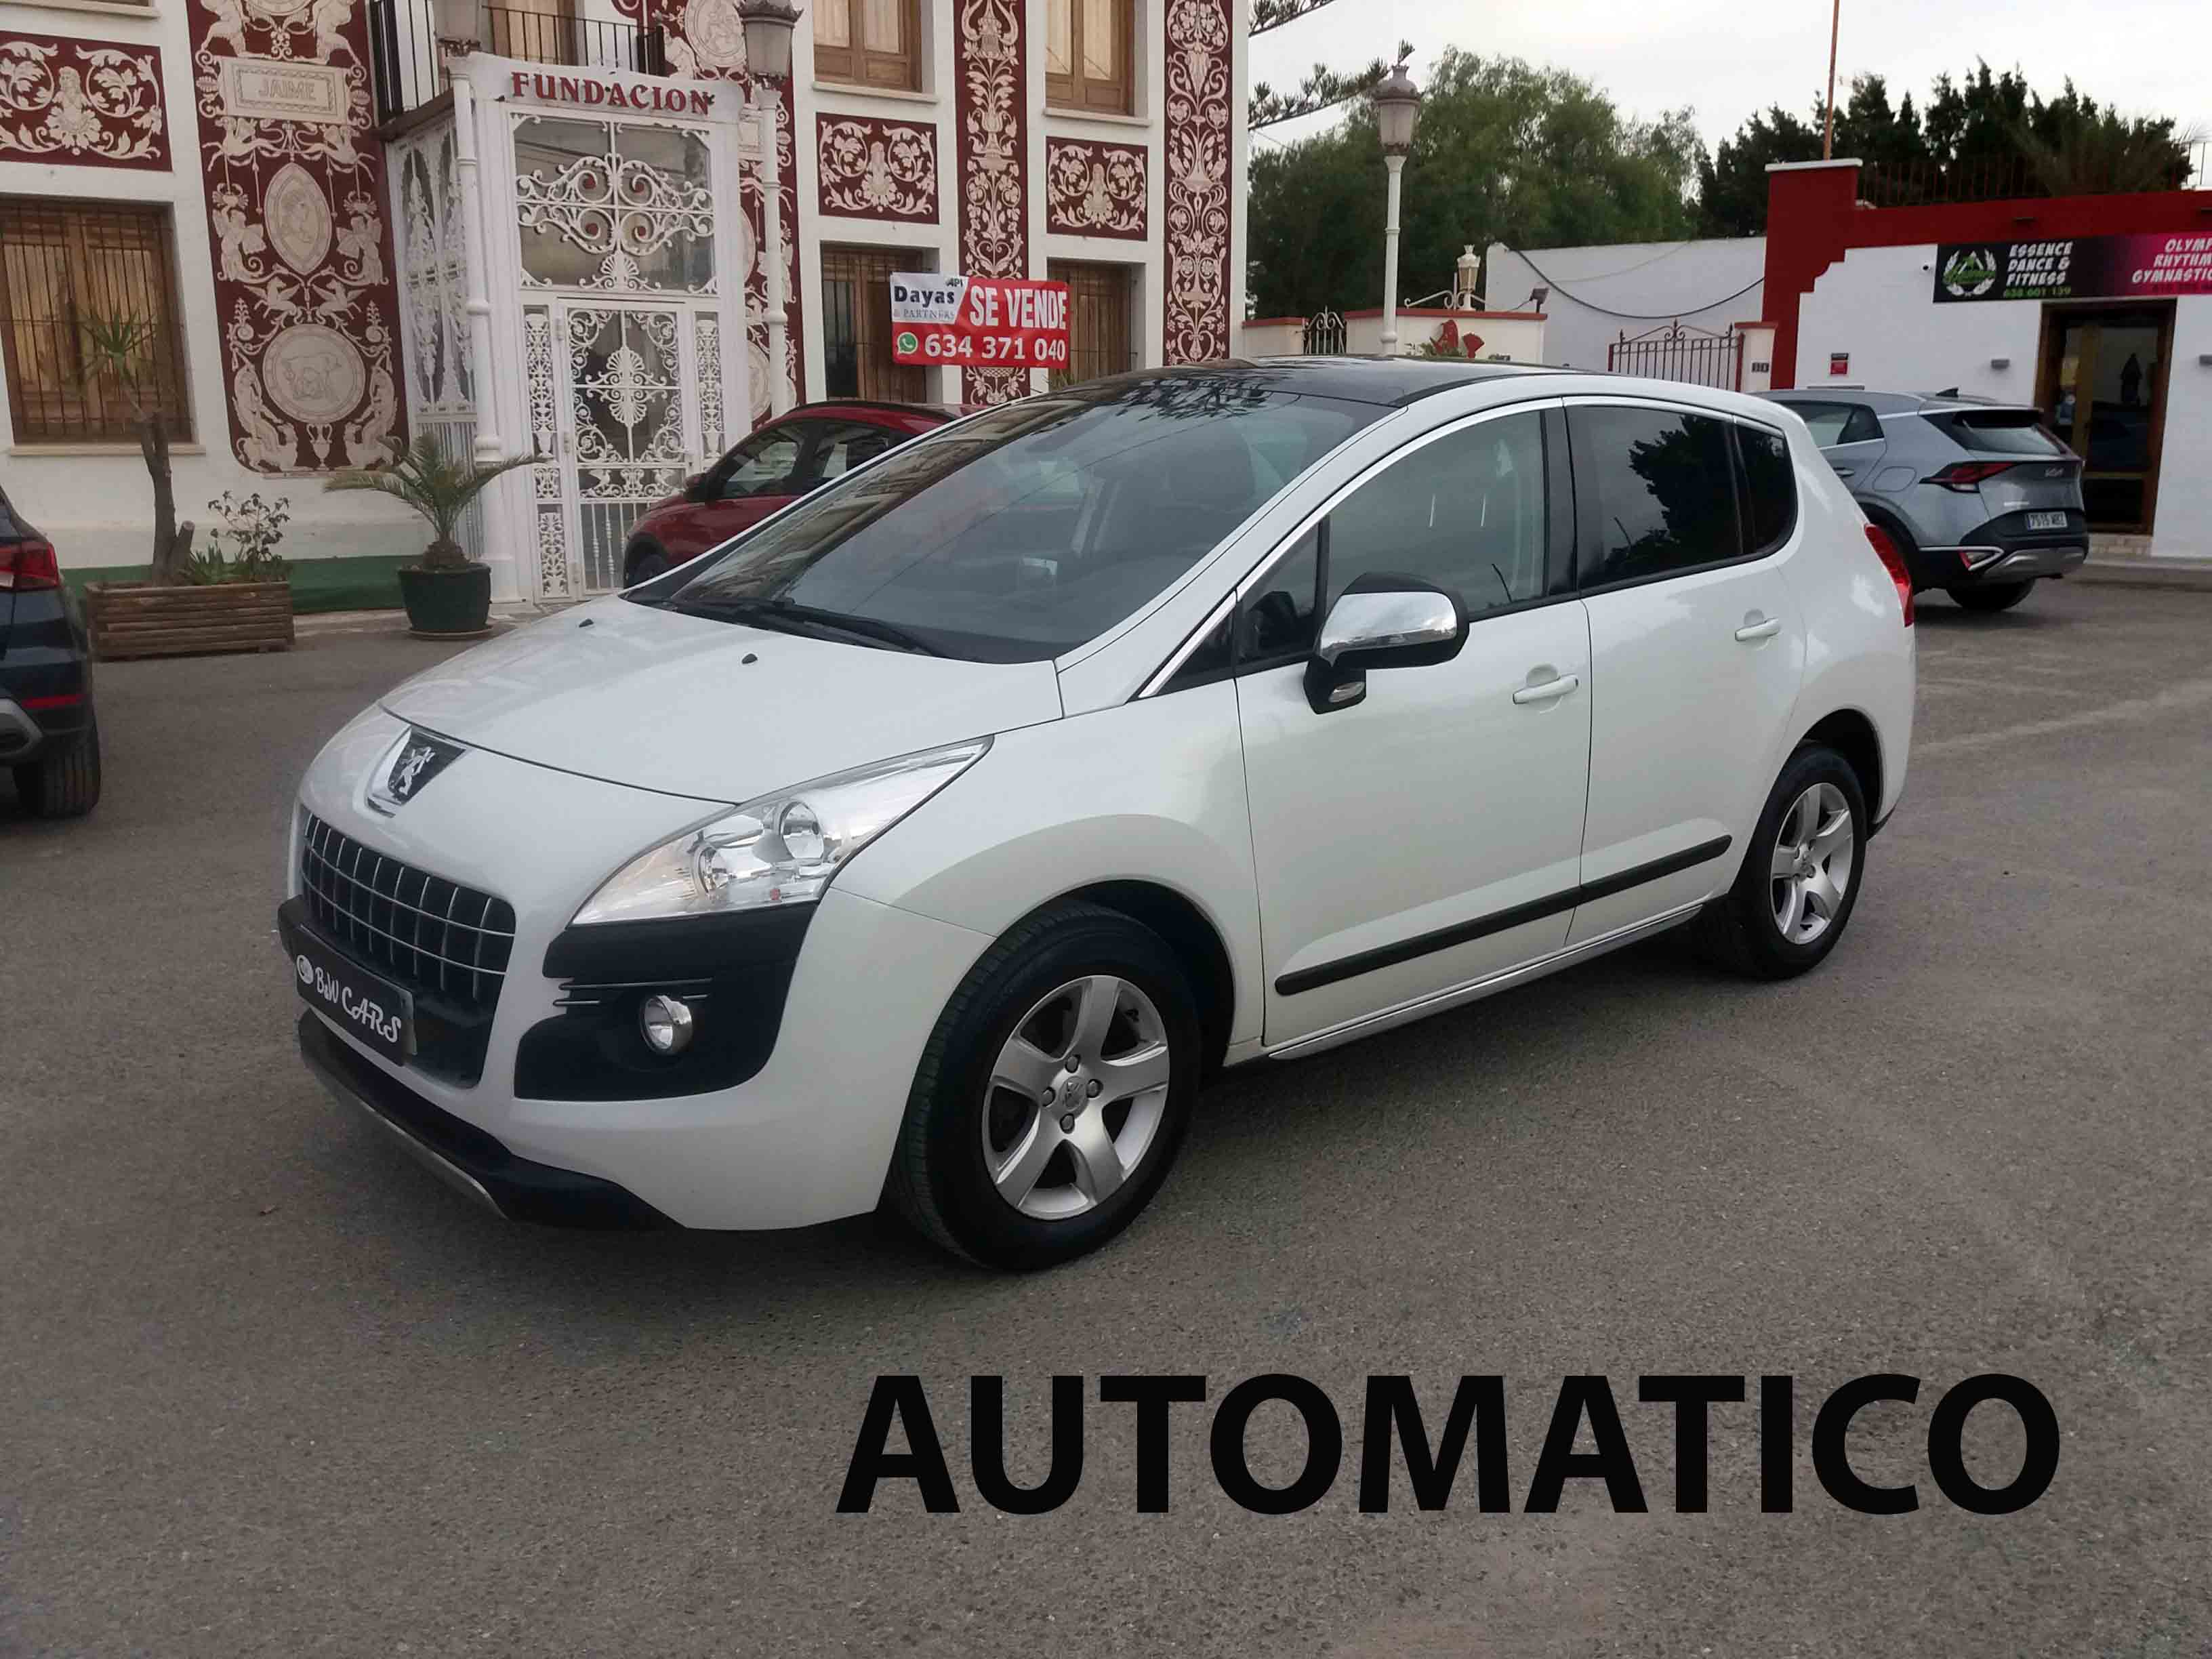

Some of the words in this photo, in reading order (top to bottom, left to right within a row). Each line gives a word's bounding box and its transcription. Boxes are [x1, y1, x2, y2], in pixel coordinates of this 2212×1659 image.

[258, 78, 317, 101] JAIME
[510, 71, 710, 116] FUNDACION
[2009, 242, 2074, 258] ESSENCE
[2007, 257, 2053, 272] DANCE
[2006, 271, 2067, 286] FITNESS
[895, 285, 955, 308] Dayas
[970, 285, 998, 327] SE
[1004, 288, 1067, 331] VENDE
[924, 333, 973, 359] 634
[981, 335, 1025, 359] 371
[1034, 338, 1066, 362] 040
[342, 986, 402, 1043] CARS
